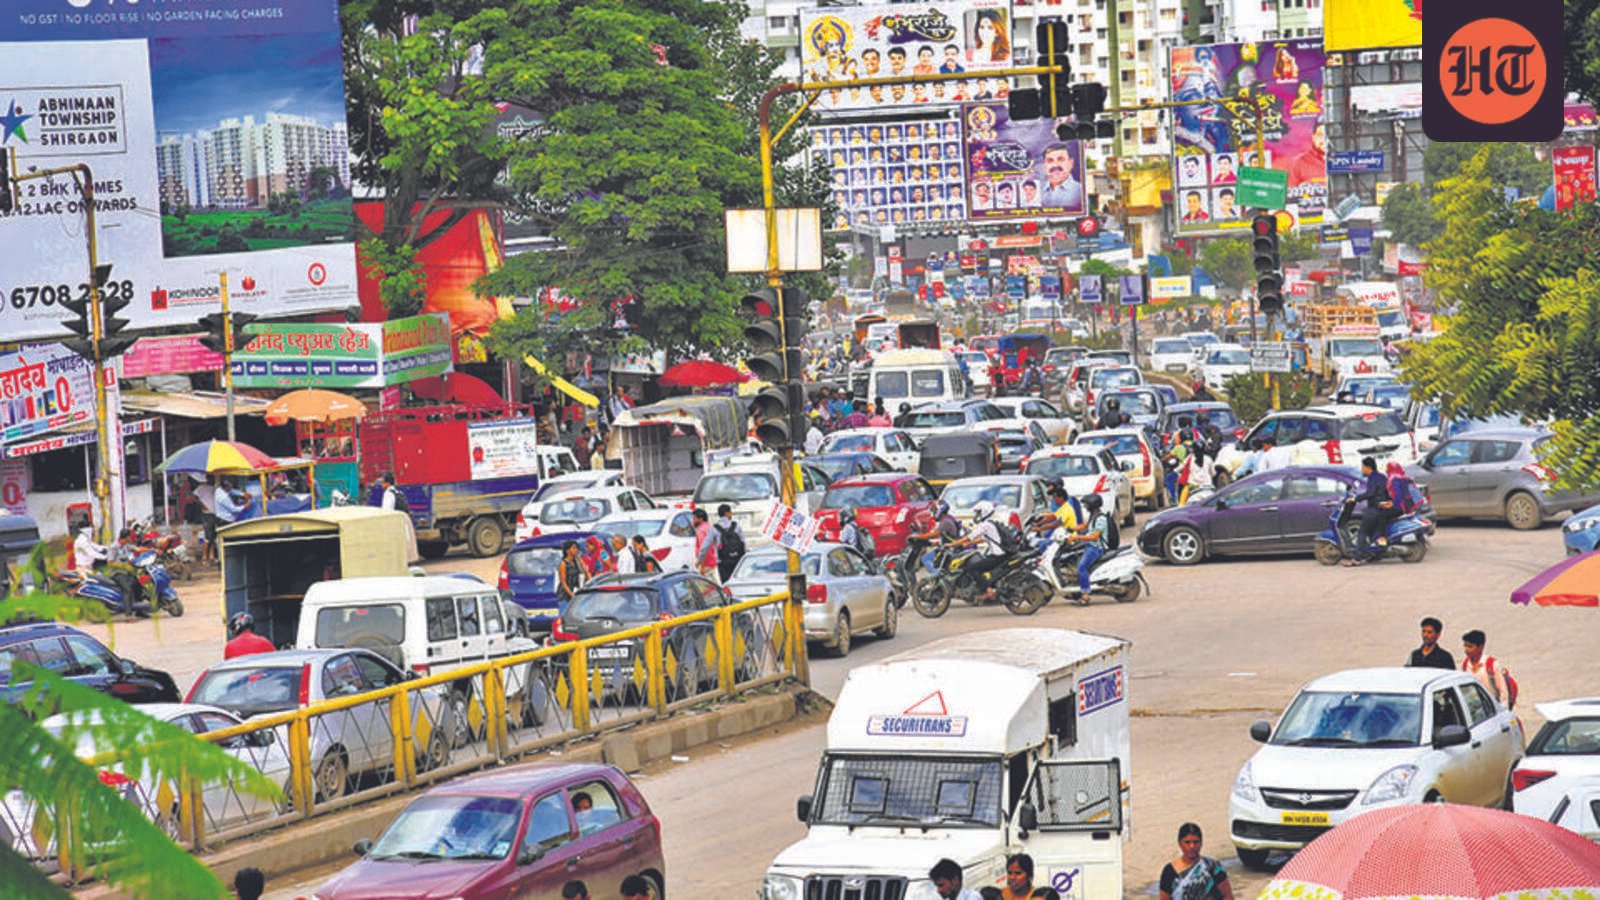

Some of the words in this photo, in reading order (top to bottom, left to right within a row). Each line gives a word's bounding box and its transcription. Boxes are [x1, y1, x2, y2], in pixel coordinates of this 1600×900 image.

[20, 14, 36, 24] NO
[38, 14, 58, 24] GST
[66, 14, 81, 24] NO
[146, 11, 161, 21] NO
[164, 11, 203, 21] GARDEN
[205, 9, 239, 20] FACING
[241, 7, 283, 19] CHARGES
[40, 96, 115, 111] ABHIMAAN
[40, 111, 116, 126] TOWNSHIP
[41, 131, 118, 146] SHIRGAON
[27, 184, 36, 197] 2
[40, 182, 70, 196] BHK
[73, 180, 123, 196] HMES
[11, 284, 71, 309] 6708
[169, 286, 220, 299] KOHINOOR
[0, 355, 46, 399] हादेव
[882, 717, 953, 733] SECURITRANS
